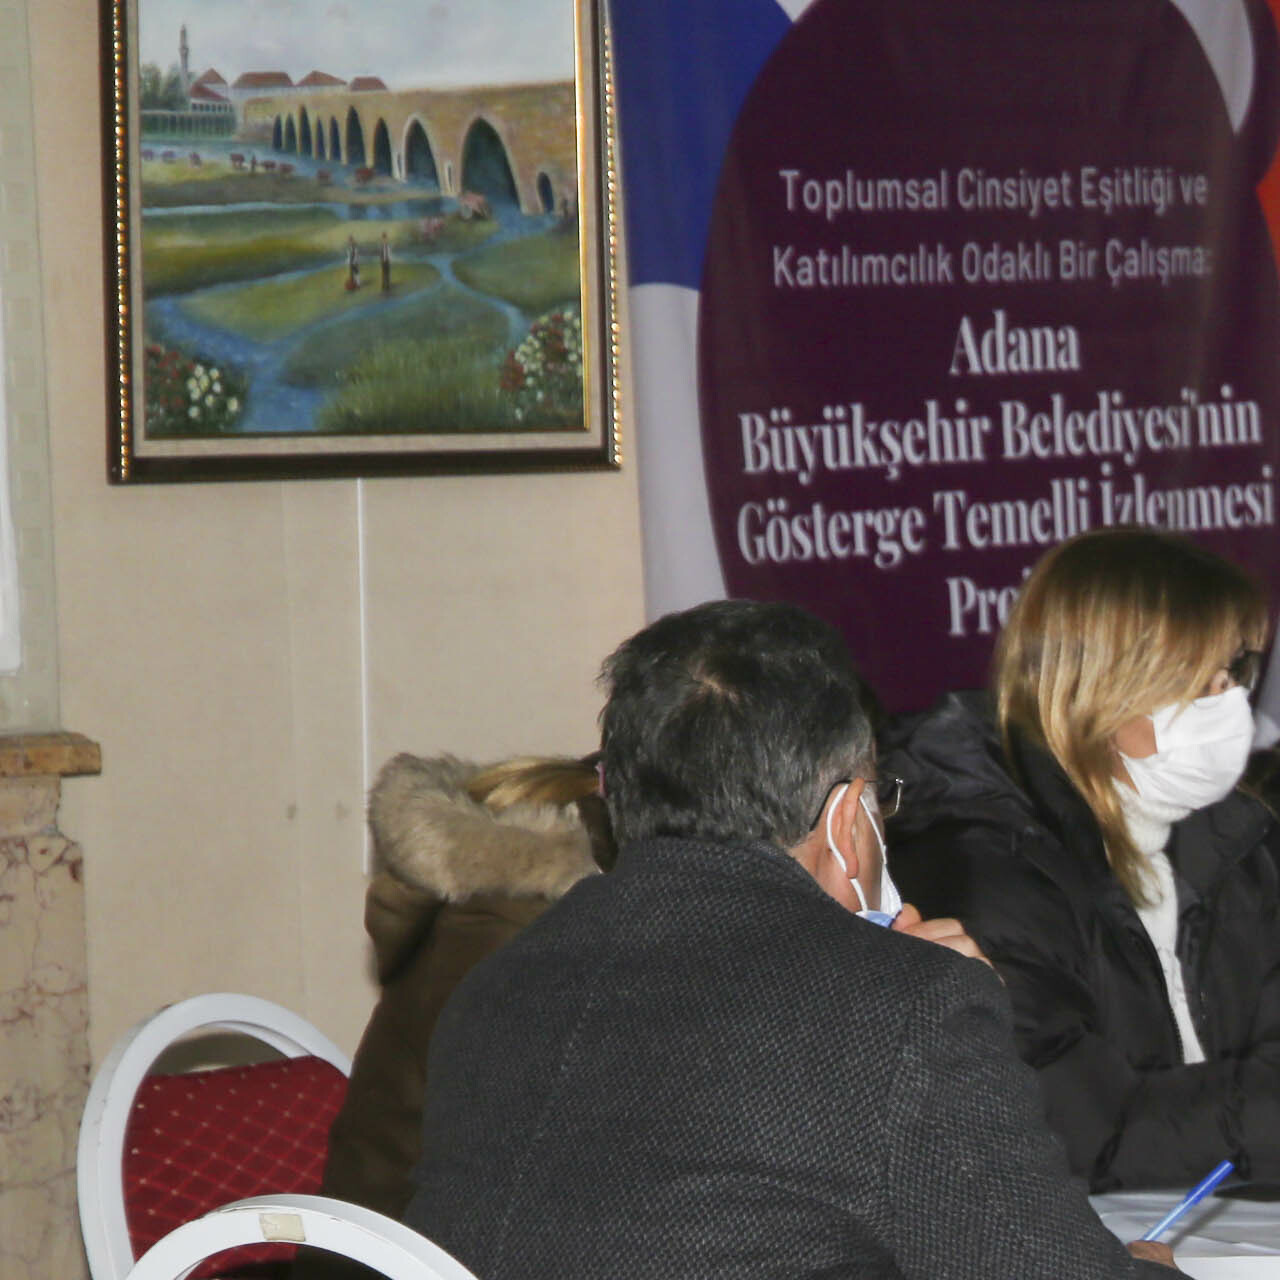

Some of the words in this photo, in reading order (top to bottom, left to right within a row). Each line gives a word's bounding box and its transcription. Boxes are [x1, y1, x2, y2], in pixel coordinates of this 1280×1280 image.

[779, 169, 948, 221] Toplumsal
[957, 168, 1073, 218] Cinsiyet
[1079, 166, 1175, 216] Eşitliği
[1180, 173, 1208, 207] ve
[773, 243, 954, 288] Katılımcılık
[961, 241, 1052, 284] Odaklı
[1058, 239, 1097, 281] Bir
[948, 309, 1081, 377] Adana
[738, 398, 992, 486] Büyükşehir
[1000, 384, 1263, 466] Belediyesi'nin
[737, 498, 926, 570] Gösterge
[932, 474, 1091, 551] Temelli
[1099, 461, 1275, 532] İzlenmesi
